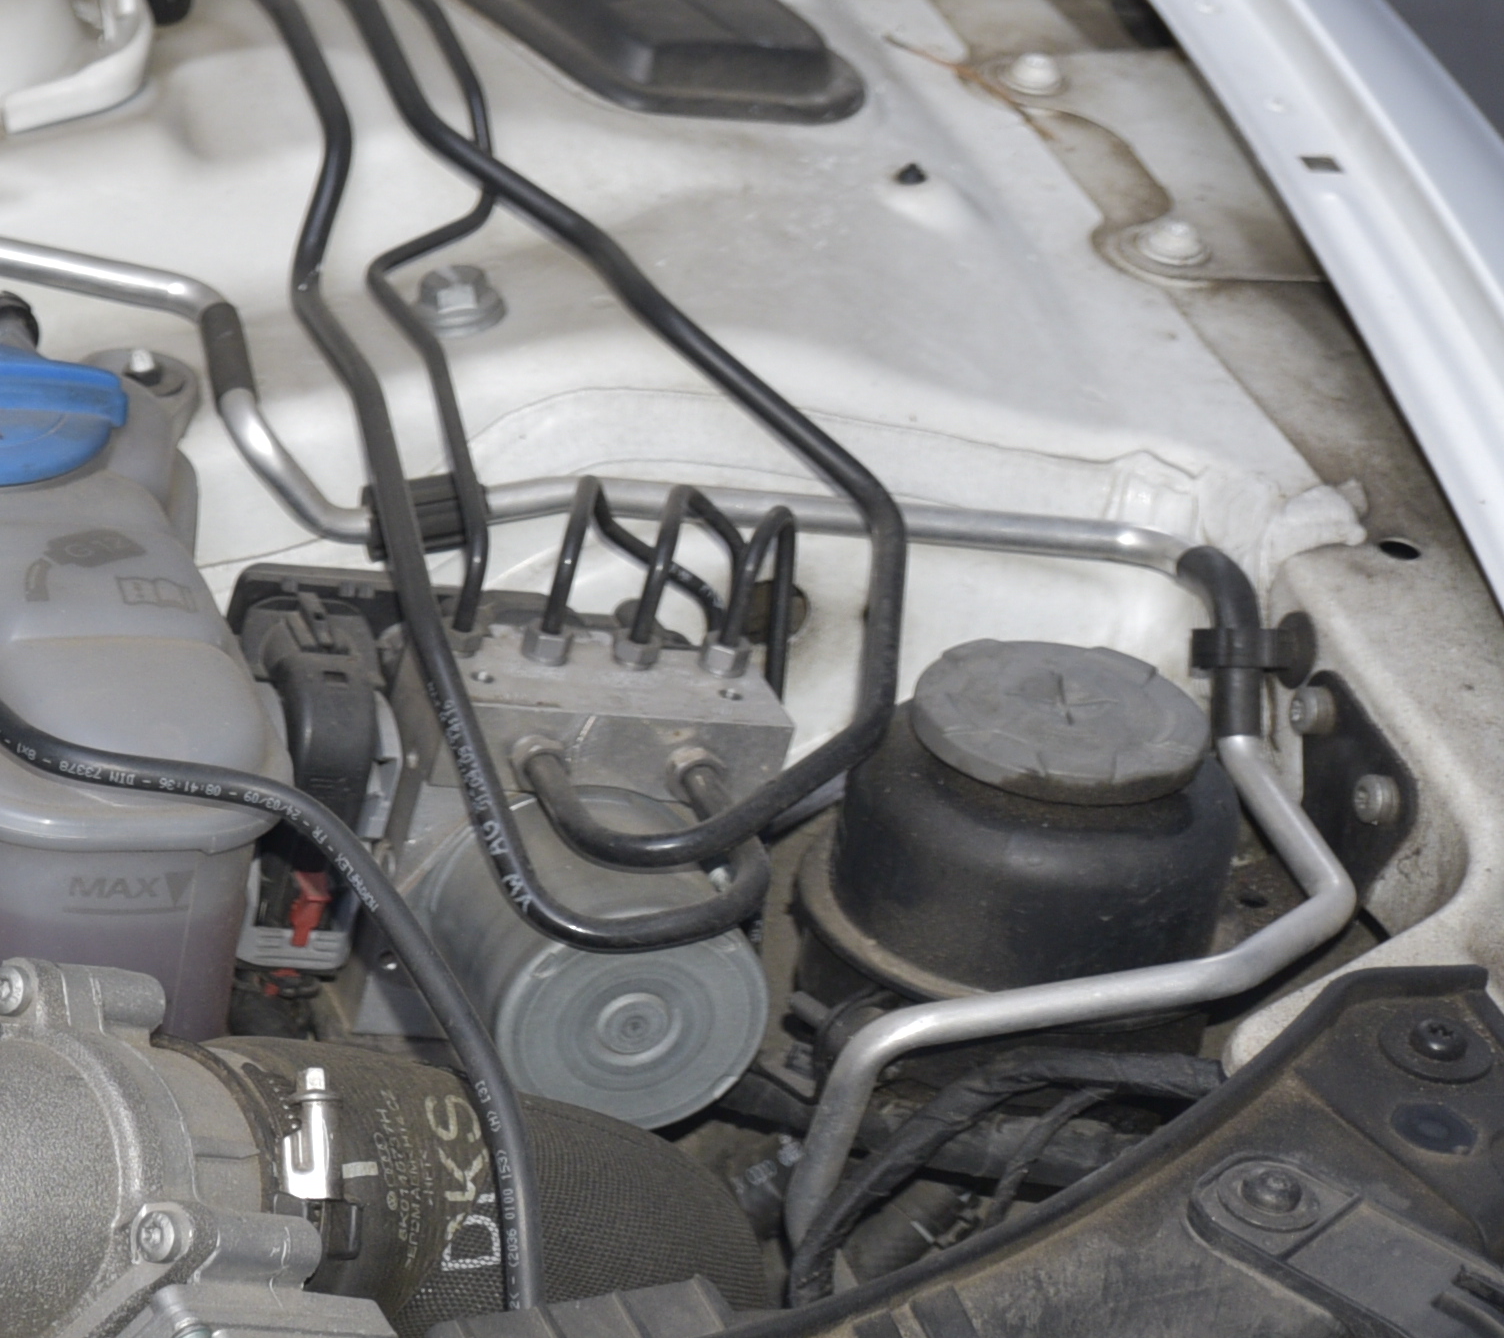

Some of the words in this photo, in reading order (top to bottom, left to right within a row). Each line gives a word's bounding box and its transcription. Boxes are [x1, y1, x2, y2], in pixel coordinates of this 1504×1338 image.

[59, 761, 103, 780] 73378
[158, 776, 222, 797] 08:41:36
[243, 790, 302, 821] 24/03/09
[311, 825, 328, 845] FR
[68, 876, 161, 899] MAX
[497, 1149, 513, 1180] 153)
[503, 1188, 515, 1221] 0100
[507, 1228, 519, 1268] (2036
